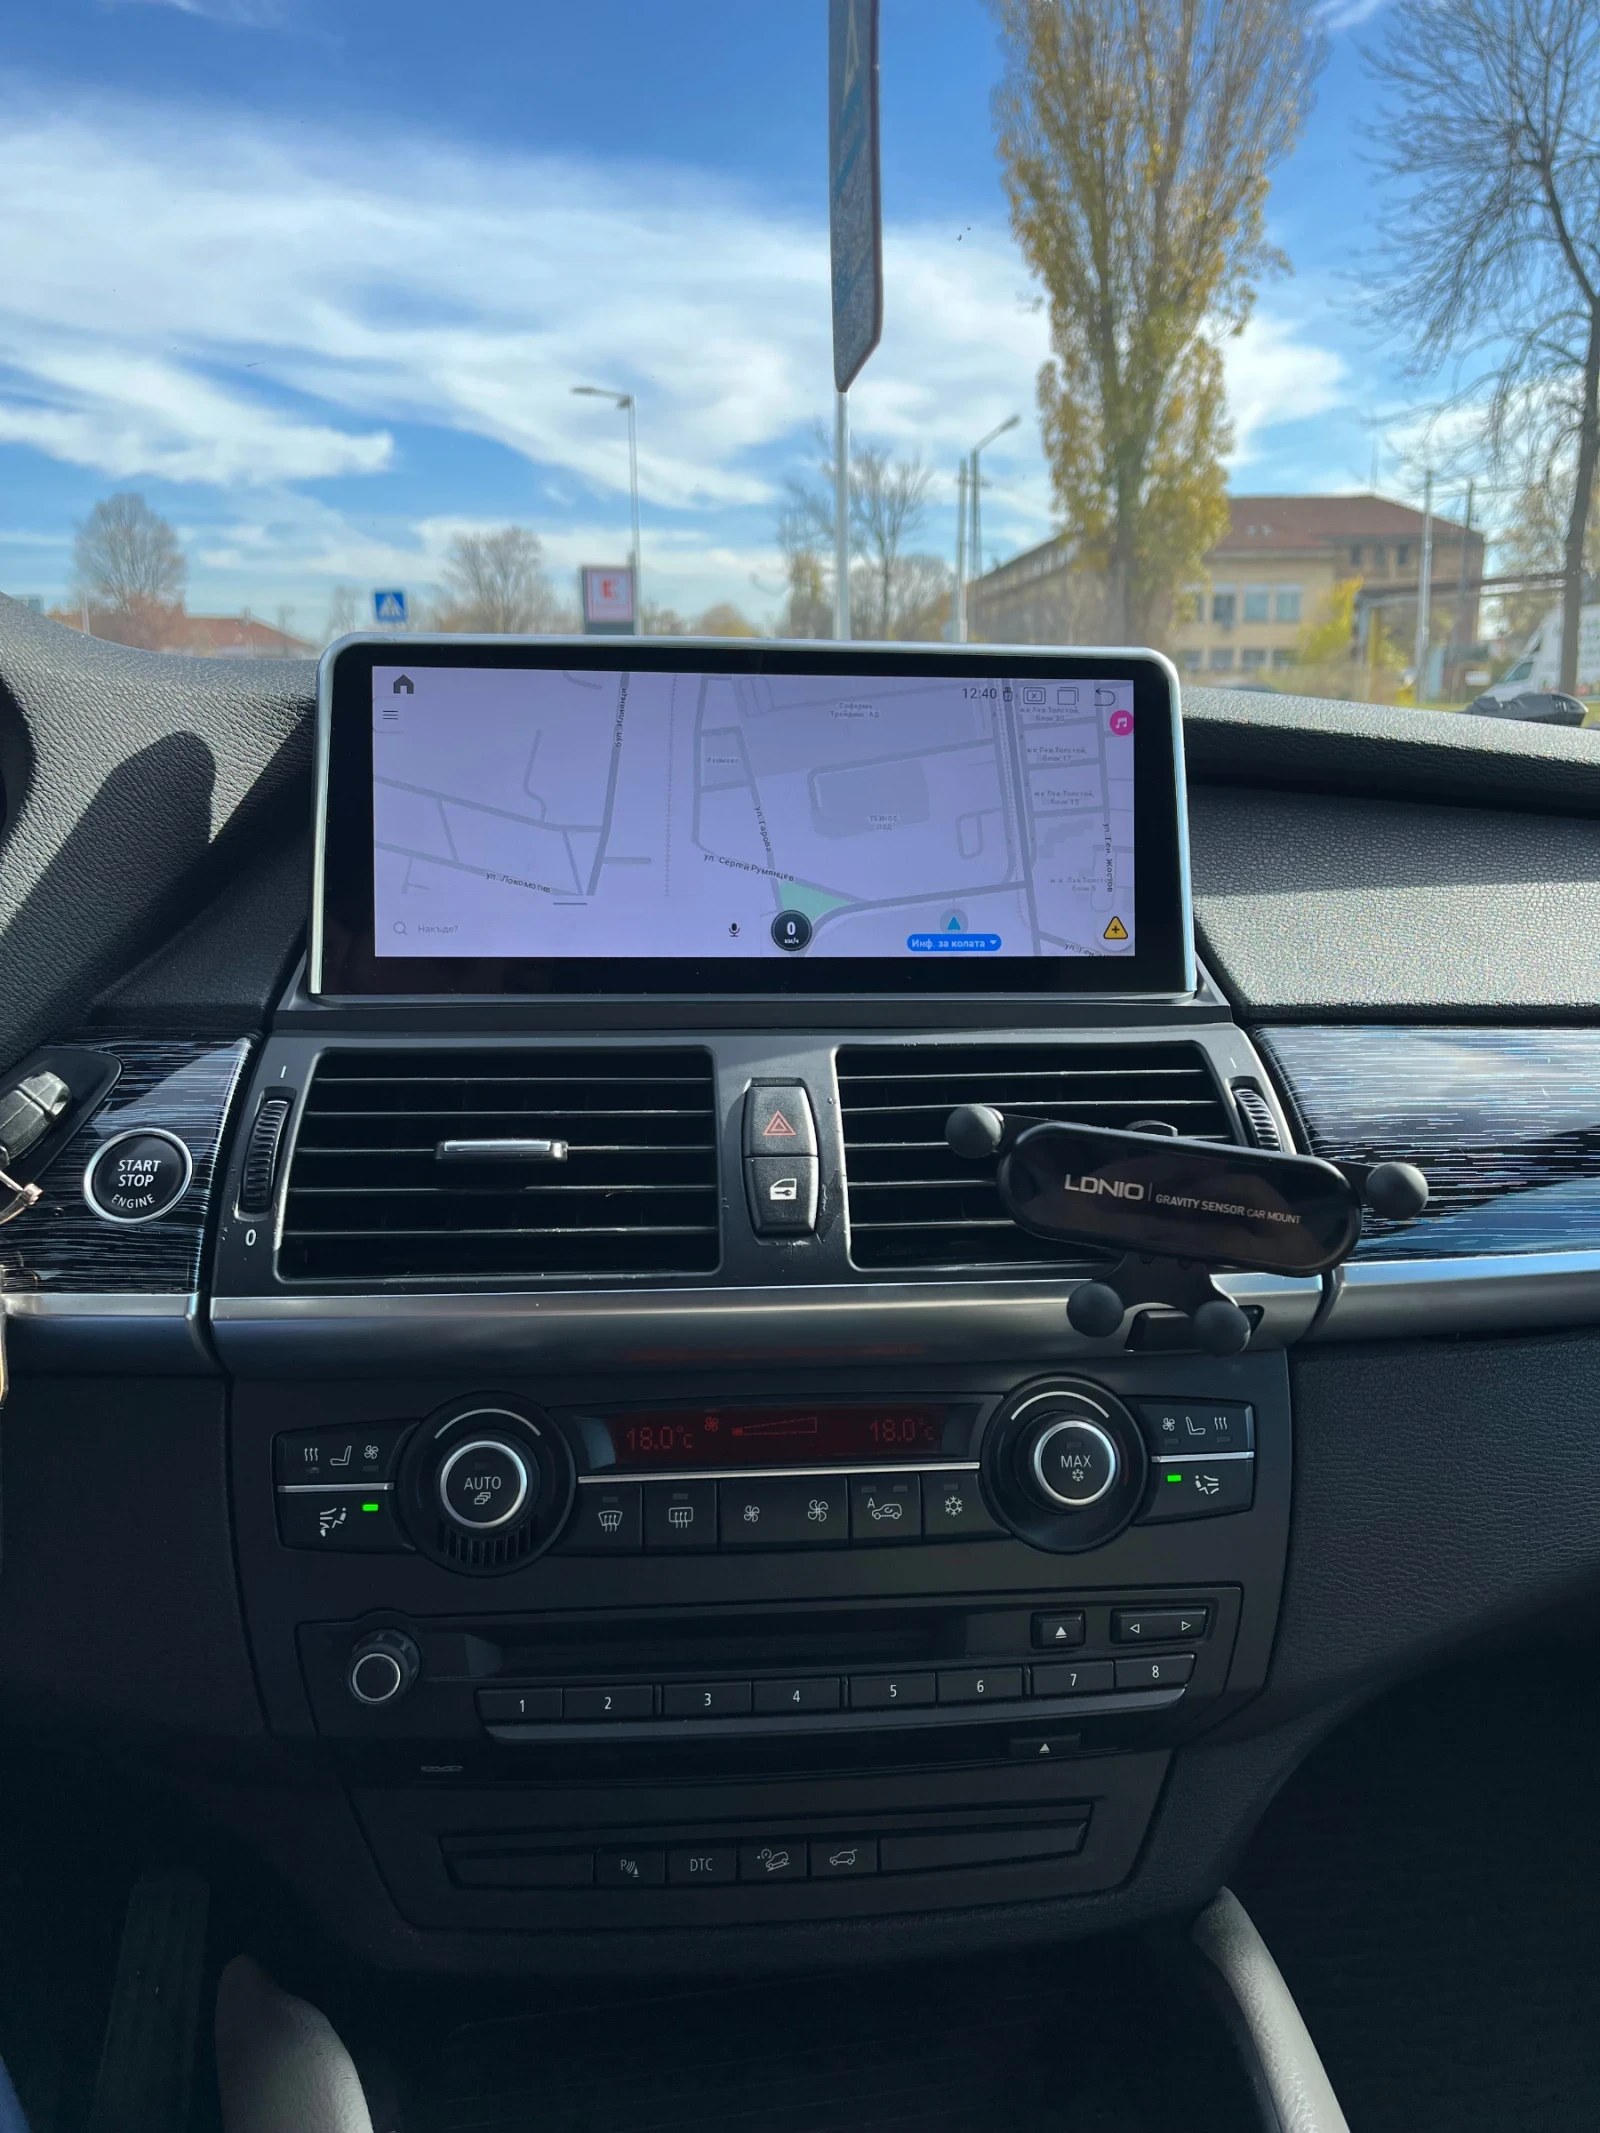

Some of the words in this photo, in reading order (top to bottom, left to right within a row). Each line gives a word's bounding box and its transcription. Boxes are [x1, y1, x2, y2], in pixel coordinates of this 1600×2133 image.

[962, 687, 997, 699] 12:40
[616, 688, 628, 727] Илиянци
[758, 820, 772, 853] Гарова
[1102, 823, 1110, 836] ул.
[1104, 837, 1112, 857] Ген.
[703, 853, 717, 862] ул.
[718, 856, 750, 871] Сергей
[750, 864, 795, 882] Румянцев
[486, 872, 499, 881] ул.
[501, 875, 551, 893] Локомотив
[417, 924, 459, 935] Накъде?
[787, 921, 796, 936] 0
[784, 937, 799, 945] км/ч
[911, 937, 936, 950] Инф.
[938, 940, 949, 948] за
[951, 940, 986, 948] колата
[117, 1159, 162, 1172] START
[117, 1173, 155, 1187] STOP
[111, 1193, 156, 1209] ENGINE
[1063, 1173, 1144, 1201] LDNIO
[1155, 1193, 1200, 1210] GRAVITY
[1200, 1200, 1245, 1217] SENSOR
[1246, 1207, 1267, 1220] CAR
[1267, 1210, 1302, 1225] MOUNT
[245, 1229, 257, 1246] 0
[1060, 1454, 1092, 1469] MAX
[463, 1475, 502, 1491] AUTO
[867, 1497, 876, 1509] A
[519, 1699, 526, 1713] 1
[603, 1696, 612, 1710] 2
[703, 1692, 712, 1707] 3
[791, 1689, 801, 1703] 4
[889, 1684, 898, 1698] 5
[976, 1679, 985, 1693] 6
[1069, 1673, 1078, 1687] 7
[1151, 1665, 1160, 1680] 8
[689, 1857, 714, 1872] DTC
